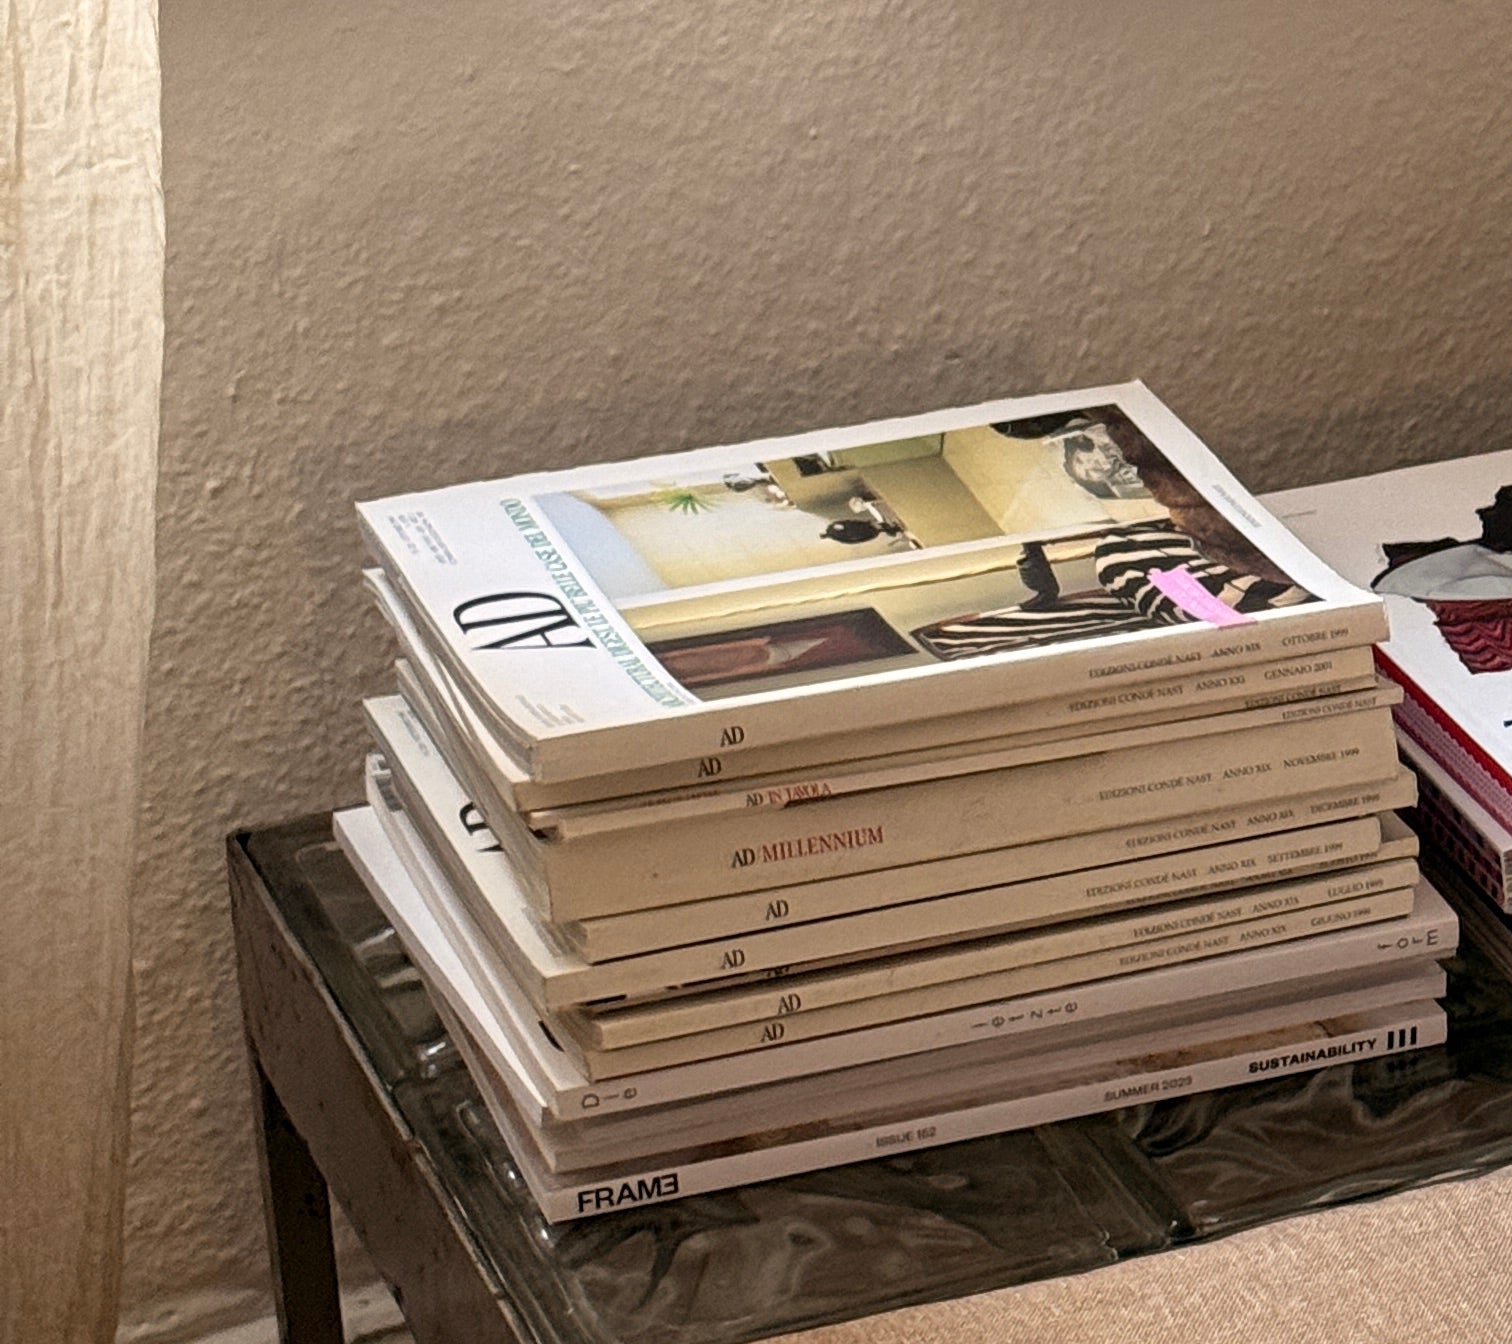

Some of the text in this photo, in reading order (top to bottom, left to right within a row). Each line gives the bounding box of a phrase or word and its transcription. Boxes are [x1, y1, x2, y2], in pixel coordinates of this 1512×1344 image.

[500, 498, 540, 532] MONDO
[523, 527, 553, 549] DEL
[535, 546, 568, 575] CASE
[552, 570, 588, 603] BELLE
[453, 591, 597, 650] AD
[1281, 628, 1327, 646] OTTOBRE
[1329, 625, 1349, 638] 1999
[1156, 684, 1184, 698] NAST
[1194, 677, 1228, 692] ANNO
[1263, 664, 1312, 681] GENNAIO
[1313, 661, 1332, 673] 2001
[720, 726, 745, 747] AD
[698, 756, 722, 777] AD
[1222, 764, 1255, 779] ANNO
[1282, 749, 1337, 769] NOVEMBRE
[1339, 745, 1360, 759] 1999
[1309, 795, 1359, 814] DICEMBRE
[732, 826, 884, 868] AD MILLENNIUM
[1267, 844, 1322, 864] SETTEMBRE
[1323, 840, 1343, 853] 1999
[1326, 880, 1365, 898] LUGLIO
[766, 900, 789, 921] AD
[1309, 908, 1351, 927] GIUGNO
[720, 949, 745, 970] AD
[777, 993, 802, 1014] AD
[760, 1023, 785, 1043] AD
[1104, 1082, 1160, 1103] SUMMER
[1248, 1038, 1377, 1073] SUSTAINABILITY
